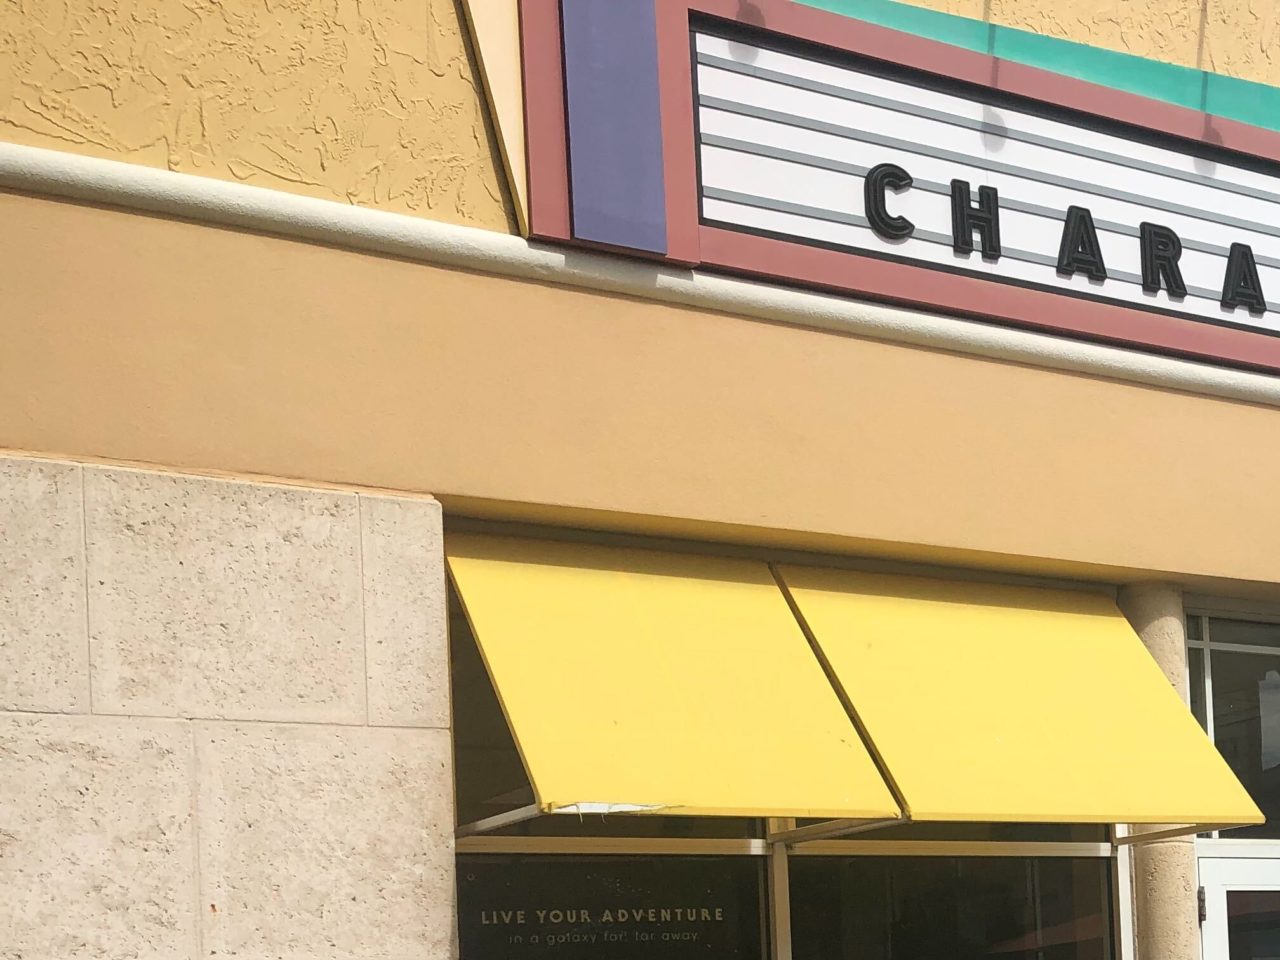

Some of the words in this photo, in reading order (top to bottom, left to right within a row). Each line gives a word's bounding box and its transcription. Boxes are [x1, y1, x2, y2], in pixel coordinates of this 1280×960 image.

[481, 910, 526, 925] LIVE
[536, 909, 591, 924] YOUR
[601, 908, 723, 922] ADVENTURE
[509, 933, 523, 944] in
[530, 934, 540, 944] a
[546, 931, 597, 946] galaxy
